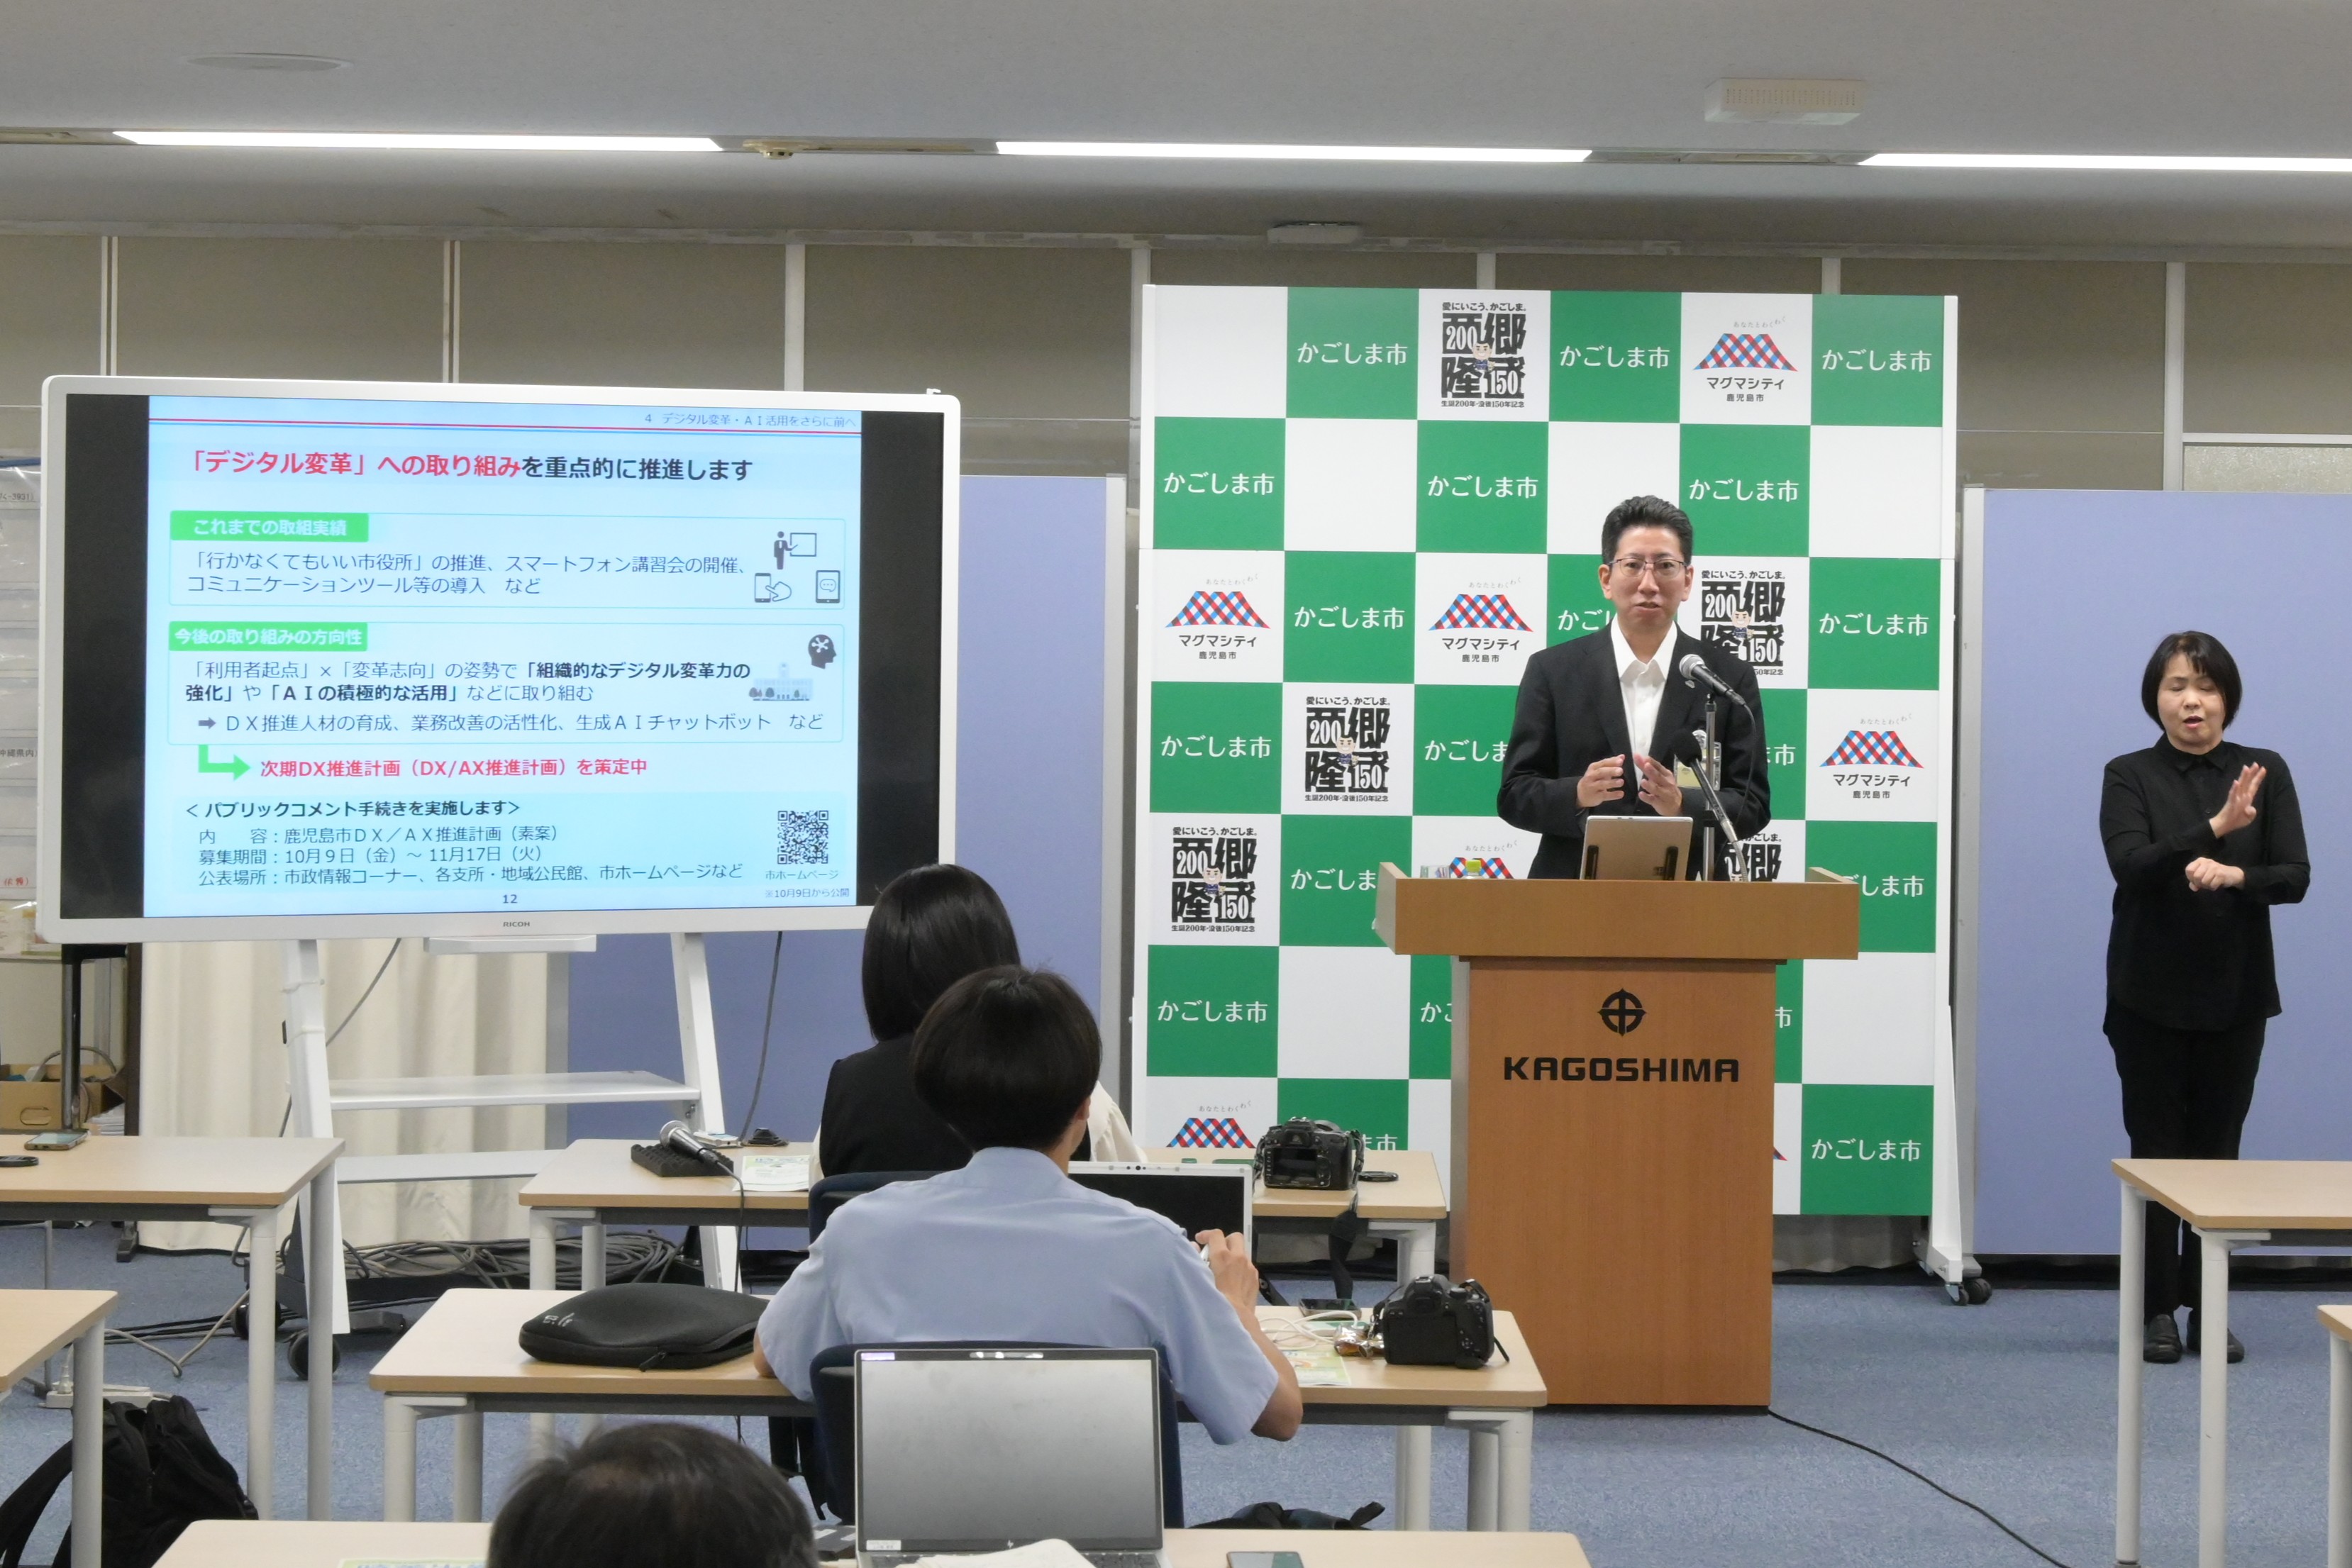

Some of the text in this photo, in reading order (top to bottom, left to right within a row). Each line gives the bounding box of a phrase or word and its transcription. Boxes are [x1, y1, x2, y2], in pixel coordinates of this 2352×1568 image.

[1442, 301, 1526, 311] 愛にいこう、かごしま。
[1297, 342, 1407, 365] かごしま市
[1560, 345, 1670, 368] かごしま市
[1822, 349, 1931, 372] かごしま市
[1707, 377, 1784, 389] マグマシティ
[196, 450, 753, 481] 「デジタル変革」への取り組みを重点的に推進します
[1164, 472, 1275, 495] かごしま市
[1428, 475, 1538, 499] かごしま市
[1690, 479, 1799, 501] かごしま市
[193, 518, 347, 537] これまでの取組実績
[189, 576, 540, 594] コミュニケーションツール等の導入 など
[1702, 570, 1785, 582] 愛にいこう、かごしま。
[1294, 606, 1404, 629] かごしま市
[1819, 613, 1929, 635] かごしま市
[174, 628, 362, 645] 今後の取り組みの方向性
[1179, 635, 1256, 647] マグマシティ
[1442, 638, 1519, 650] マグマシティ
[1306, 696, 1390, 706] 愛にいこう、かごしま。
[789, 714, 823, 729] など
[1161, 735, 1271, 758] かごしま市
[1424, 739, 1508, 762] かごしま
[1834, 774, 1910, 786] マグマシティ
[1172, 826, 1257, 836] 愛にいこう、かごしま。
[766, 870, 838, 879] 市ホームページ
[1290, 868, 1376, 891] かごしま
[1844, 874, 1924, 898] しま市
[504, 894, 517, 903] 12
[1158, 1000, 1267, 1023] かごしま市
[1503, 1057, 1740, 1082] KAGOSHIMA
[1812, 1138, 1921, 1161] かごしま市
